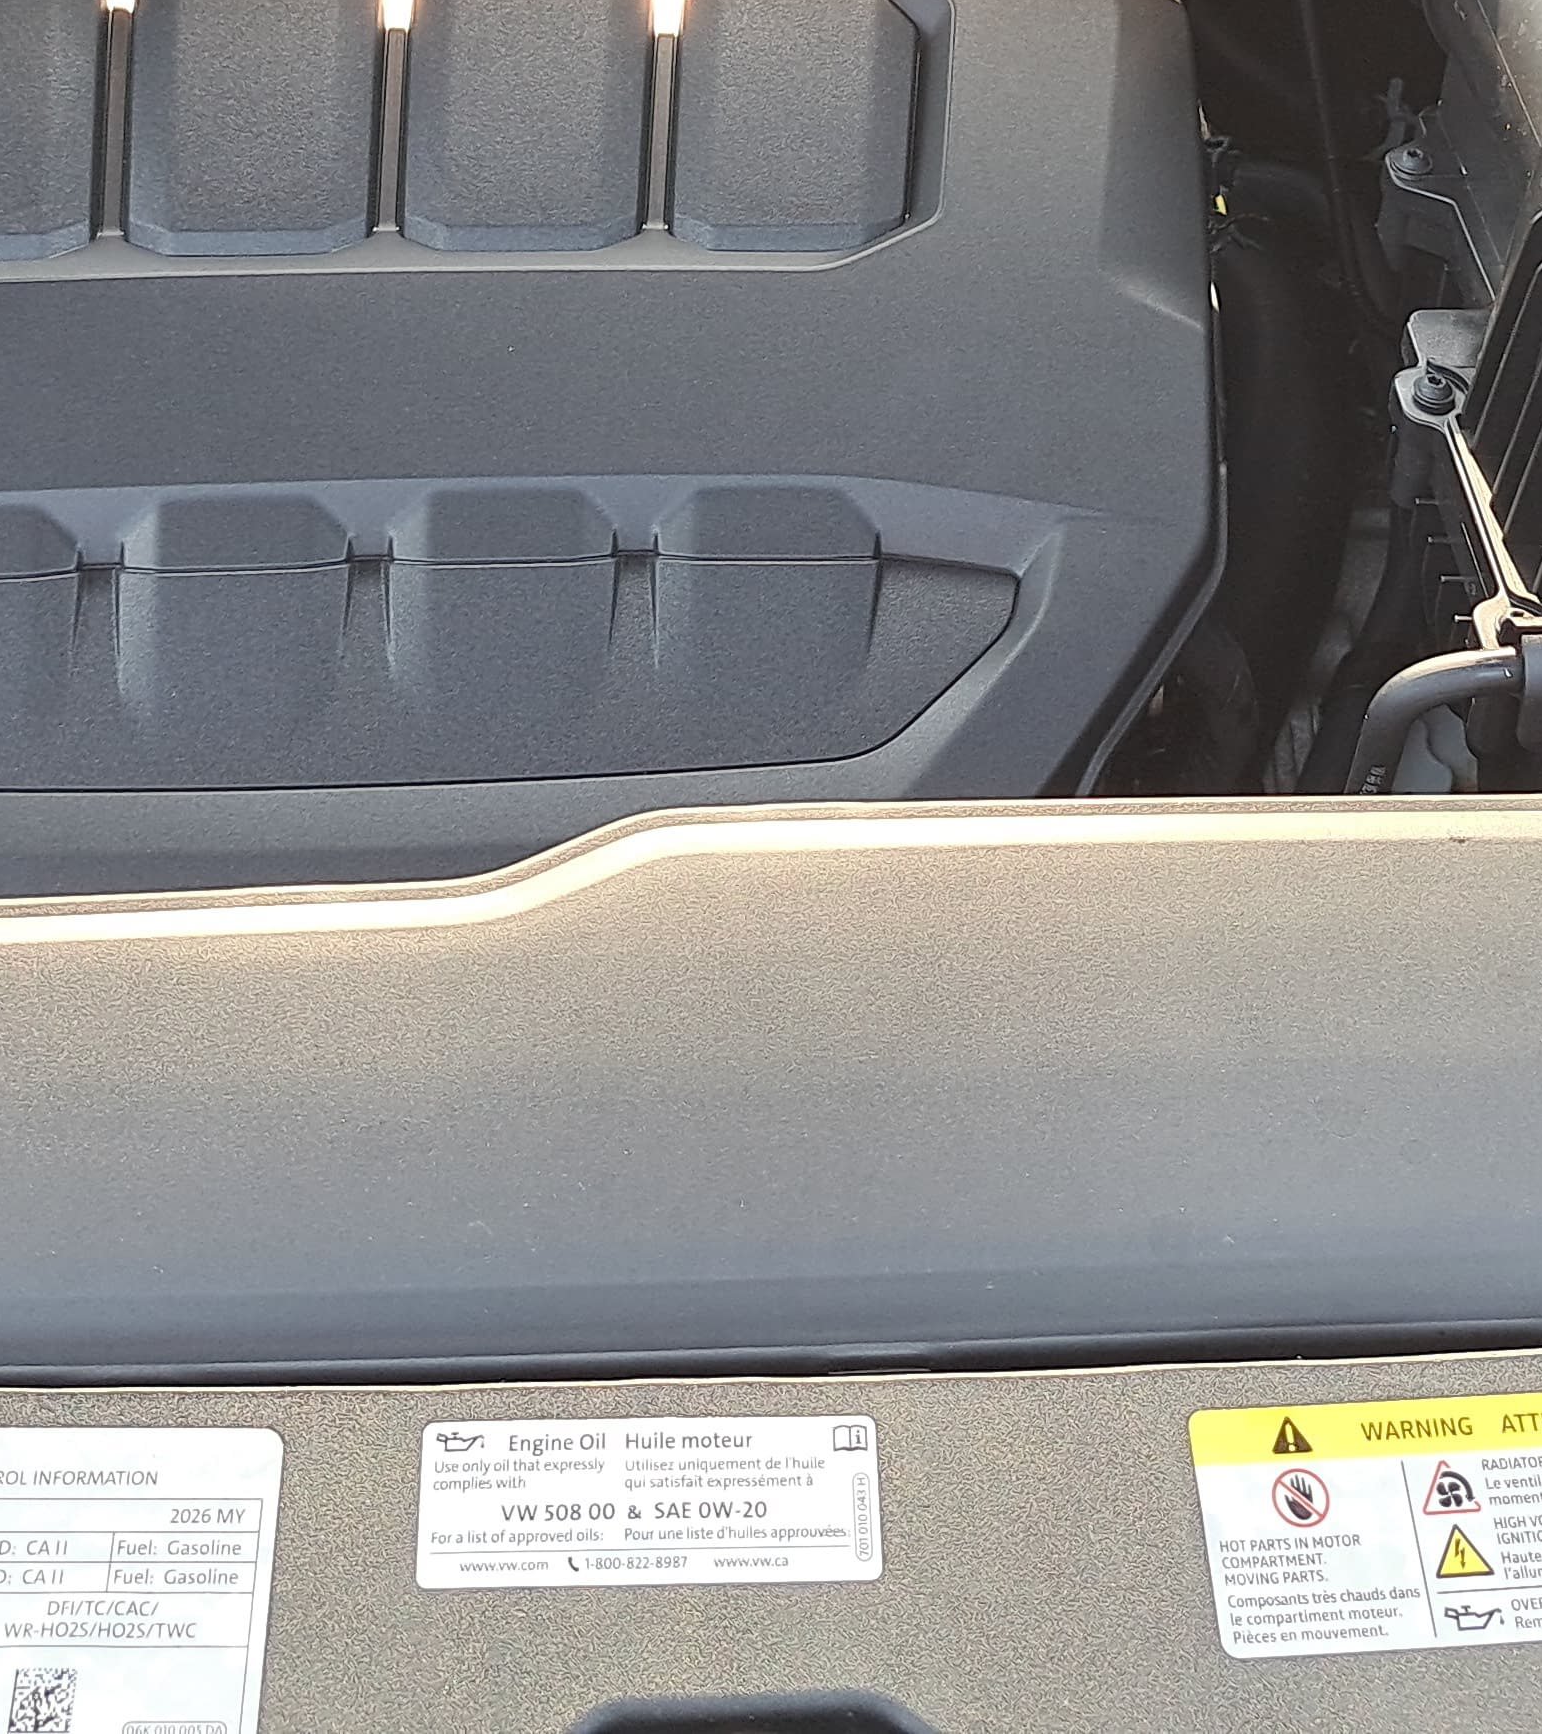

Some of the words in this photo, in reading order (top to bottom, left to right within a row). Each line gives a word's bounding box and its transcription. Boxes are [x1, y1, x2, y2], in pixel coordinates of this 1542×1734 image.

[1360, 1417, 1473, 1442] WARNING
[509, 1434, 574, 1457] Engine
[580, 1432, 606, 1451] Oil
[626, 1432, 676, 1450] Huile
[682, 1432, 752, 1449] moteur
[435, 1461, 459, 1474] Use
[462, 1458, 491, 1476] only
[493, 1459, 510, 1472] oil
[513, 1458, 541, 1472] that
[543, 1458, 605, 1475] expressly
[625, 1459, 675, 1472] Utilisez
[678, 1458, 761, 1474] uniquement
[765, 1457, 782, 1470] de
[785, 1457, 825, 1470] l'huile
[33, 1470, 158, 1486] INFORMATION
[433, 1476, 493, 1494] complies
[496, 1475, 526, 1489] with
[624, 1478, 646, 1492] qui
[649, 1474, 703, 1488] satisfait
[707, 1474, 802, 1491] expressément
[806, 1473, 814, 1487] à
[1485, 1477, 1502, 1490] Le
[170, 1508, 212, 1524] 2026
[217, 1508, 246, 1524] MY
[501, 1505, 538, 1522] VW
[544, 1504, 582, 1522] 508
[588, 1503, 615, 1521] 00
[627, 1505, 642, 1520] &
[654, 1502, 691, 1519] SAE
[699, 1501, 767, 1519] 0W-20
[1493, 1516, 1527, 1530] HIGH
[431, 1532, 452, 1545] For
[455, 1534, 464, 1544] a
[468, 1530, 488, 1544] list
[491, 1529, 506, 1544] of
[508, 1528, 573, 1547] approved
[576, 1528, 604, 1542] oils:
[624, 1528, 654, 1541] Pour
[658, 1530, 684, 1540] une
[687, 1527, 714, 1540] liste
[716, 1525, 768, 1540] d'huiles
[26, 1540, 50, 1556] CA
[117, 1539, 157, 1556] Fuel:
[167, 1539, 242, 1556] Gasoline
[1219, 1540, 1246, 1553] HOT
[1250, 1538, 1292, 1552] PARTS
[1294, 1537, 1309, 1549] IN
[1312, 1534, 1361, 1549] MOTOR
[459, 1561, 549, 1572] www.vw.com
[585, 1556, 688, 1570] 1-800-822-8987
[713, 1557, 789, 1568] www.vw.ca
[1221, 1552, 1327, 1570] COMPARTMENT.
[1500, 1551, 1542, 1565] Haute
[22, 1569, 46, 1585] CA
[114, 1568, 154, 1585] Fuel:
[164, 1568, 239, 1585] Gasoline
[1224, 1572, 1280, 1587] MOVING
[1282, 1569, 1329, 1584] PARTS.
[1227, 1594, 1310, 1611] Composants
[1311, 1590, 1337, 1604] très
[1340, 1587, 1387, 1603] chauds
[1389, 1586, 1421, 1600] dans
[47, 1600, 159, 1617] DFI/TC/CAC/
[1230, 1613, 1243, 1627] le
[1246, 1609, 1345, 1627] compartiment
[1348, 1607, 1403, 1620] moteur.
[1233, 1630, 1277, 1645] Pièces
[1280, 1631, 1297, 1642] en
[1301, 1624, 1389, 1641] mouvement.
